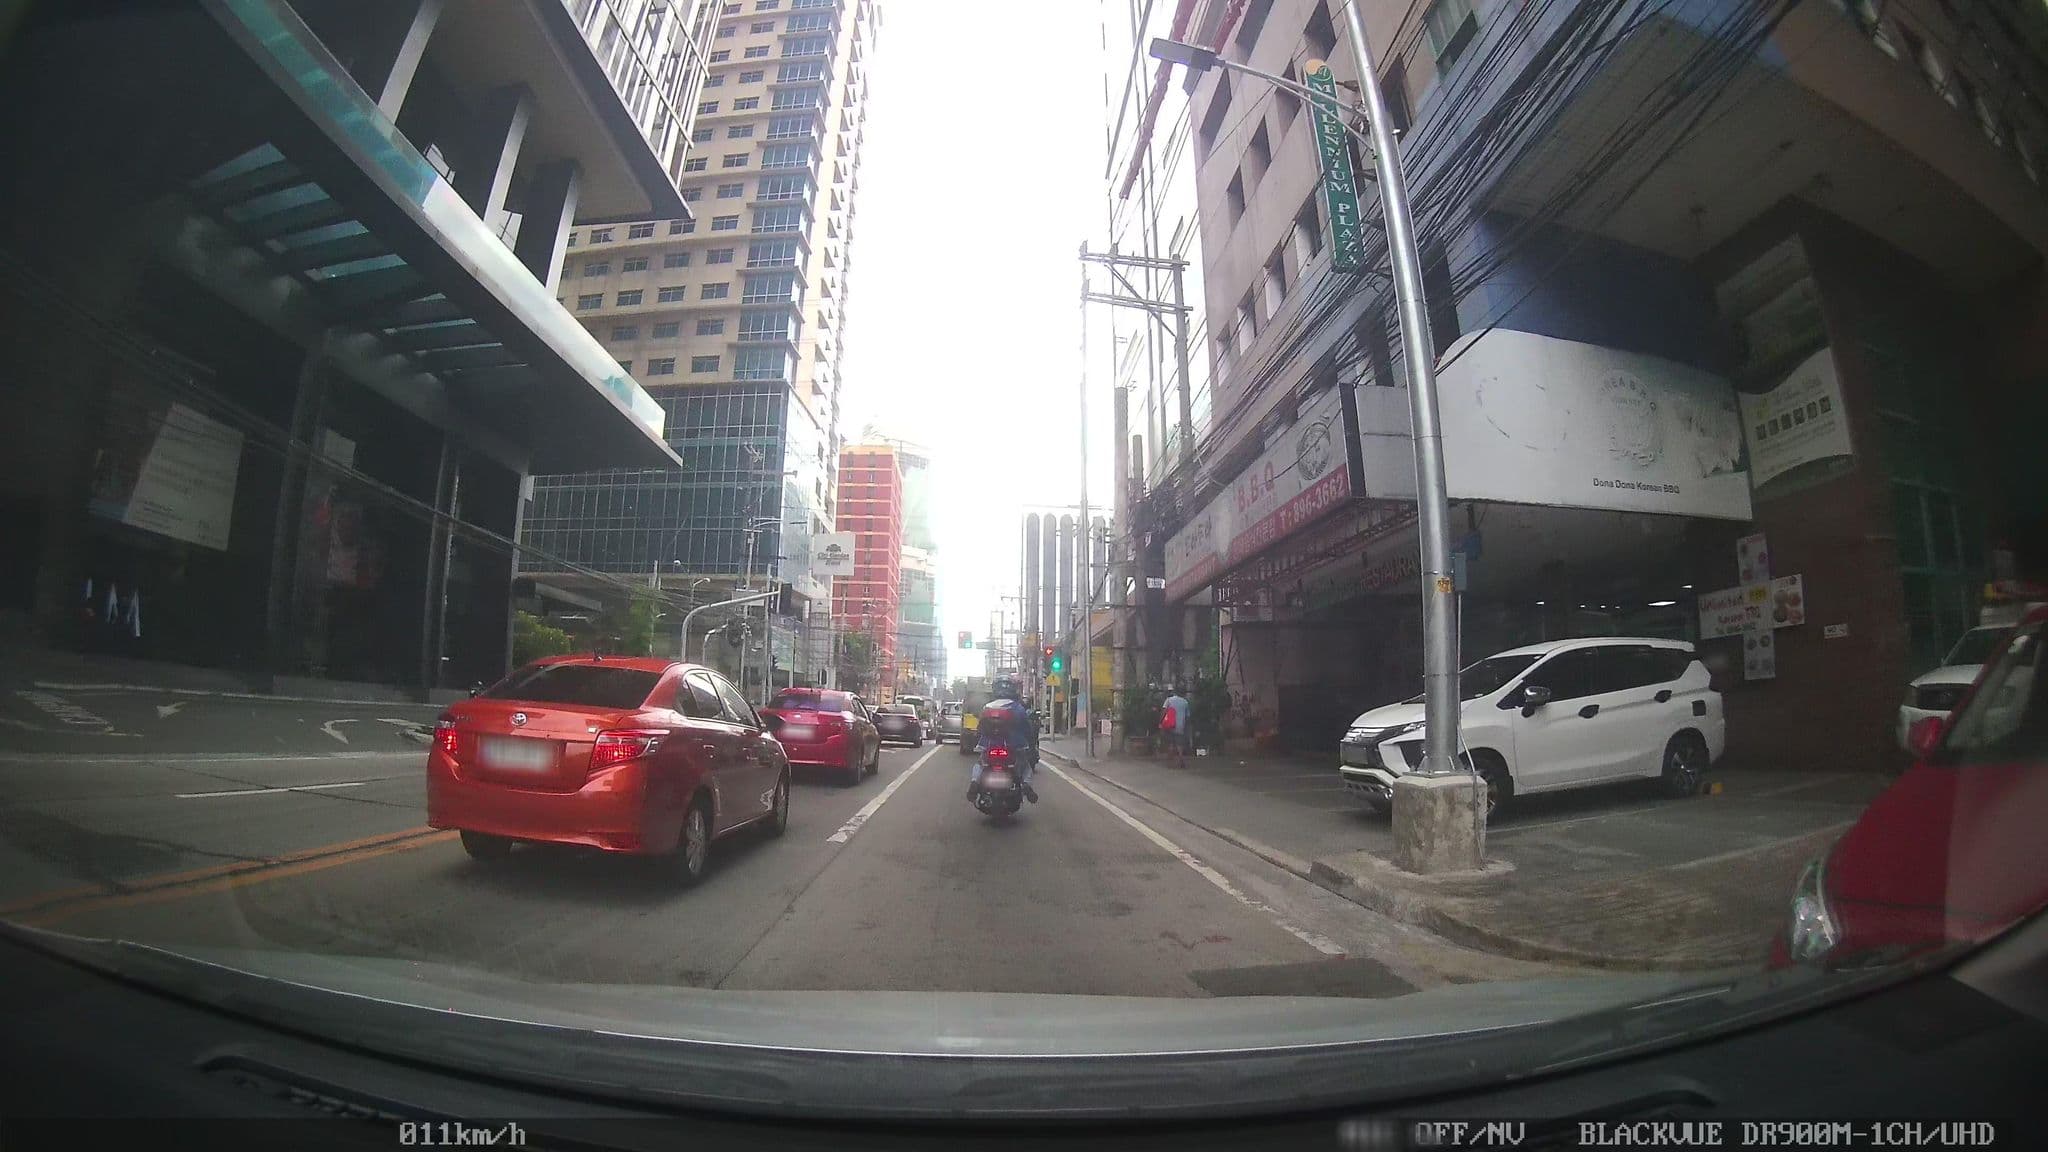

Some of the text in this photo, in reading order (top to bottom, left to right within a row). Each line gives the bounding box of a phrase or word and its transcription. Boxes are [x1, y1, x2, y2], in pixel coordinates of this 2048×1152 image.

[1313, 82, 1351, 193] MLLENNIUM
[1593, 478, 1681, 494] Dona Dona Korean BBQ
